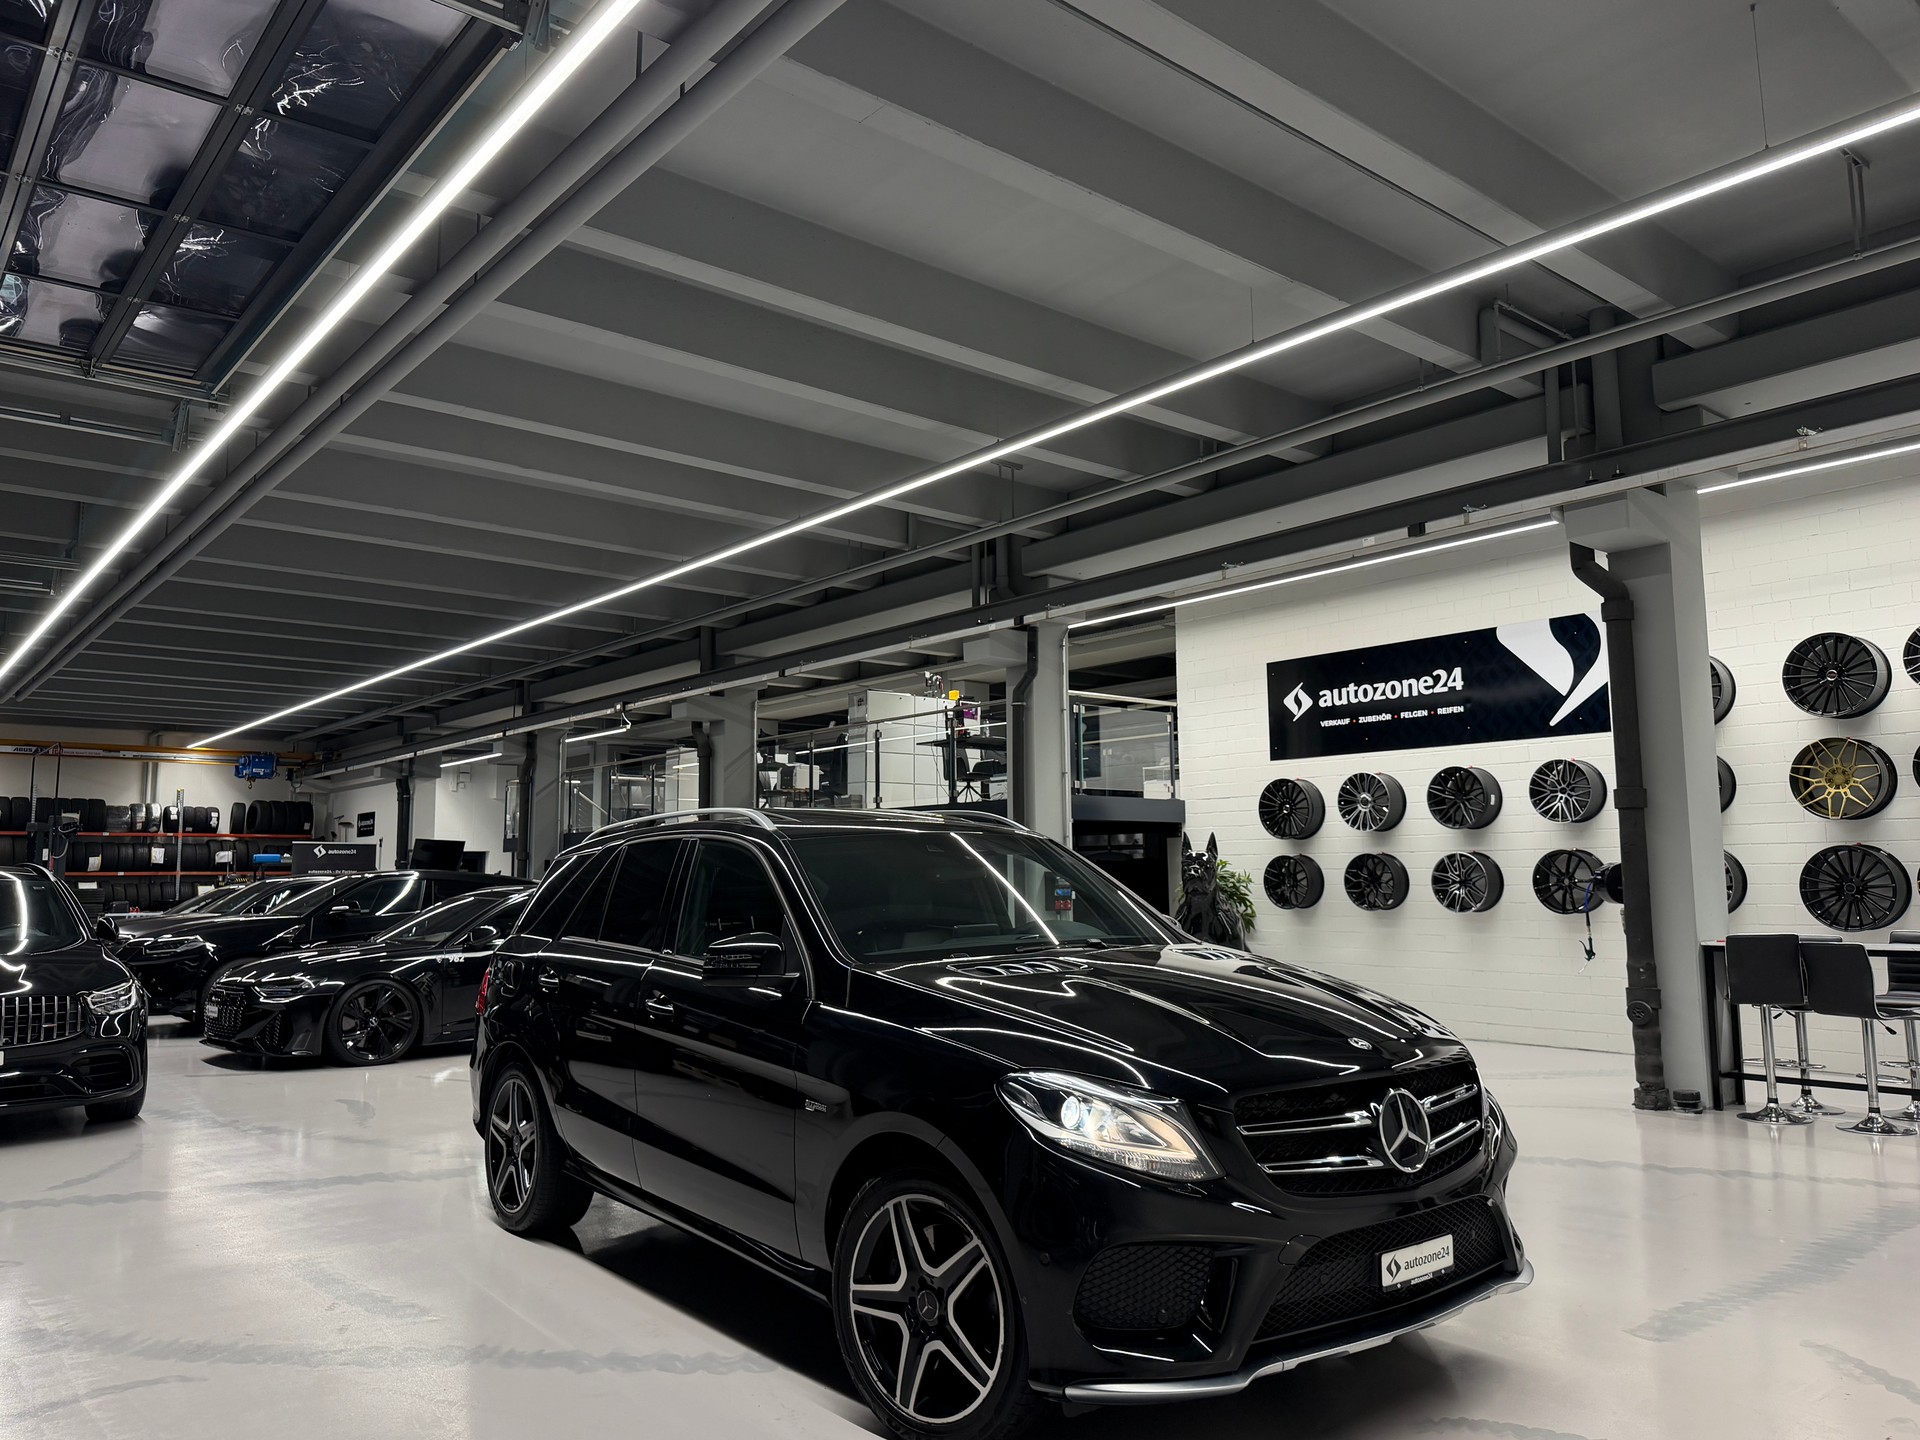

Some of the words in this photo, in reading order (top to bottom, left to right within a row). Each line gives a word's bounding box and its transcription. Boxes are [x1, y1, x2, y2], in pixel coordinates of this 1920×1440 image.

[1318, 667, 1464, 708] autozone24
[1320, 717, 1351, 727] VERKAUF
[1358, 713, 1392, 723] ZUBEHÖR
[1400, 709, 1428, 719] FELGEN
[1437, 706, 1464, 715] REIFEN
[1404, 1245, 1450, 1271] autozone24
